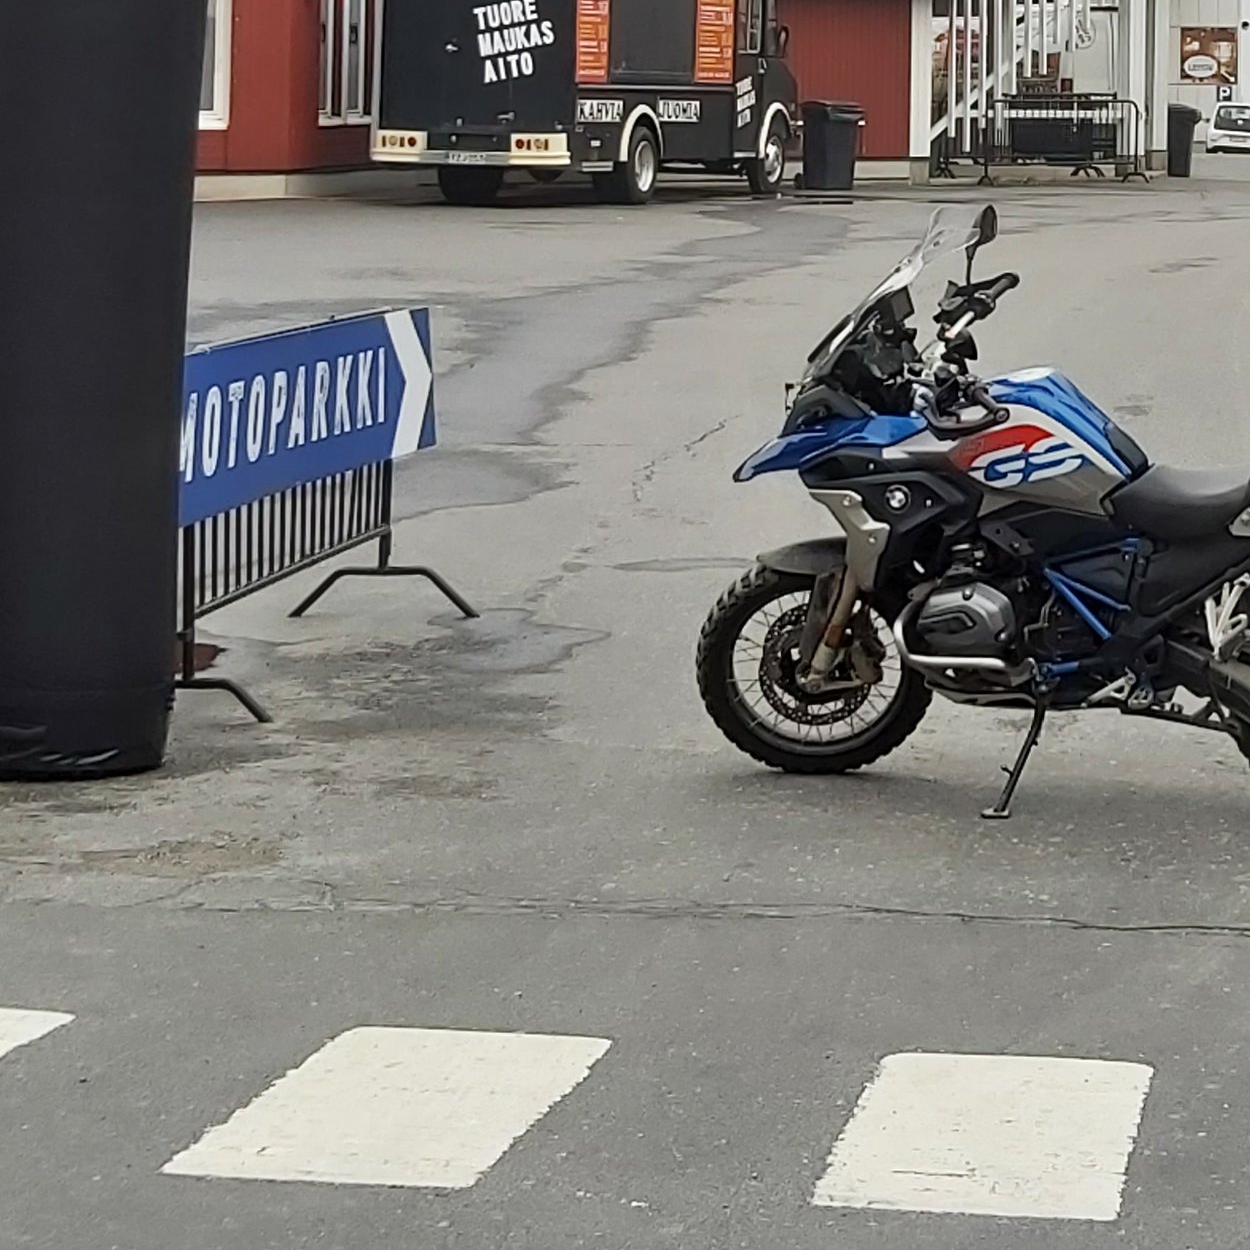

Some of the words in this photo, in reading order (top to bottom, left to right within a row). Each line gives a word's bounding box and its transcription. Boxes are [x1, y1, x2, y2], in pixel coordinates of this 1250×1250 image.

[477, 20, 555, 57] MAUKAS
[483, 51, 534, 84] AITO
[179, 347, 386, 483] MOTOPARKKI
